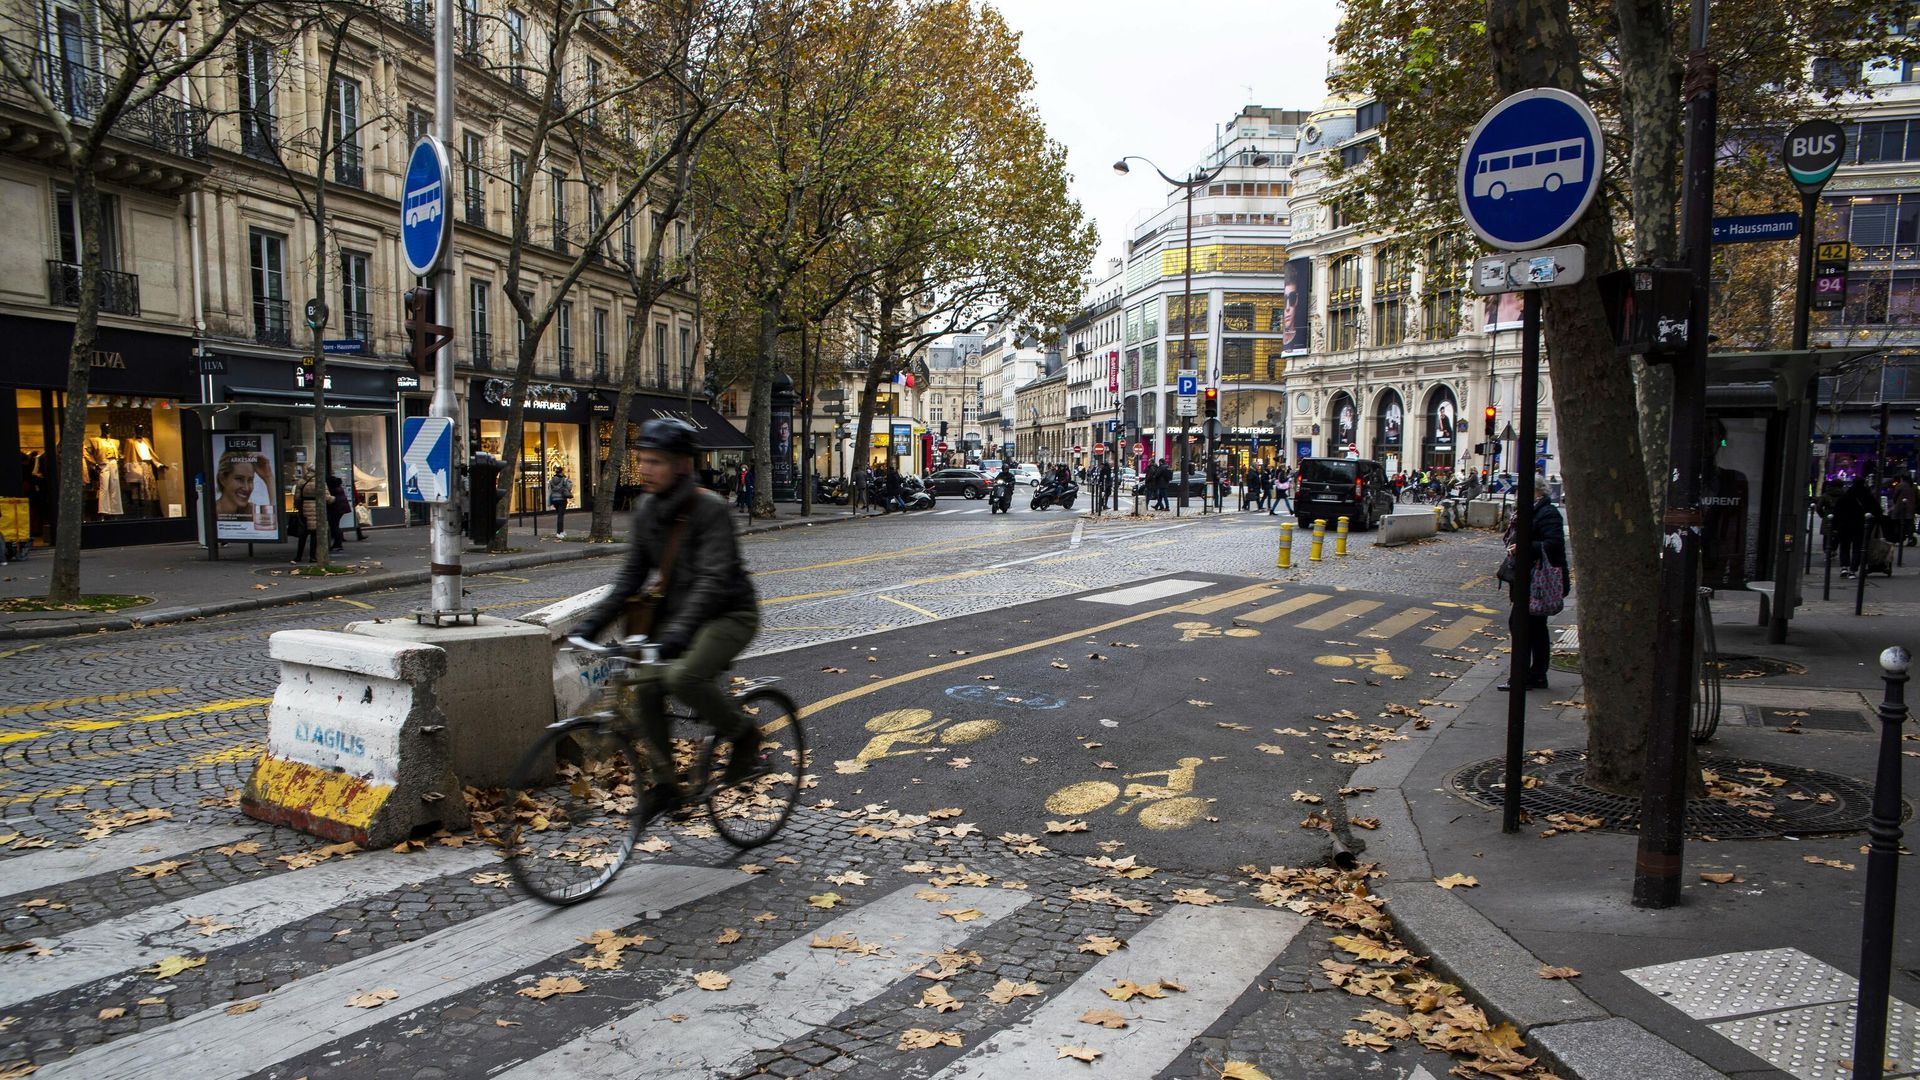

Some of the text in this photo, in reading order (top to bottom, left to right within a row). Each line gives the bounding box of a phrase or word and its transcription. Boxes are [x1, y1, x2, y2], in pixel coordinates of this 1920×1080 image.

[1792, 134, 1836, 157] BUS
[1729, 222, 1793, 235] Haussmann
[1821, 246, 1843, 258] 42
[1819, 278, 1841, 292] 94
[204, 361, 224, 370] ILVA
[1184, 380, 1192, 393] P
[533, 400, 567, 411] PARFUMEUR
[229, 440, 257, 448] LIERAC
